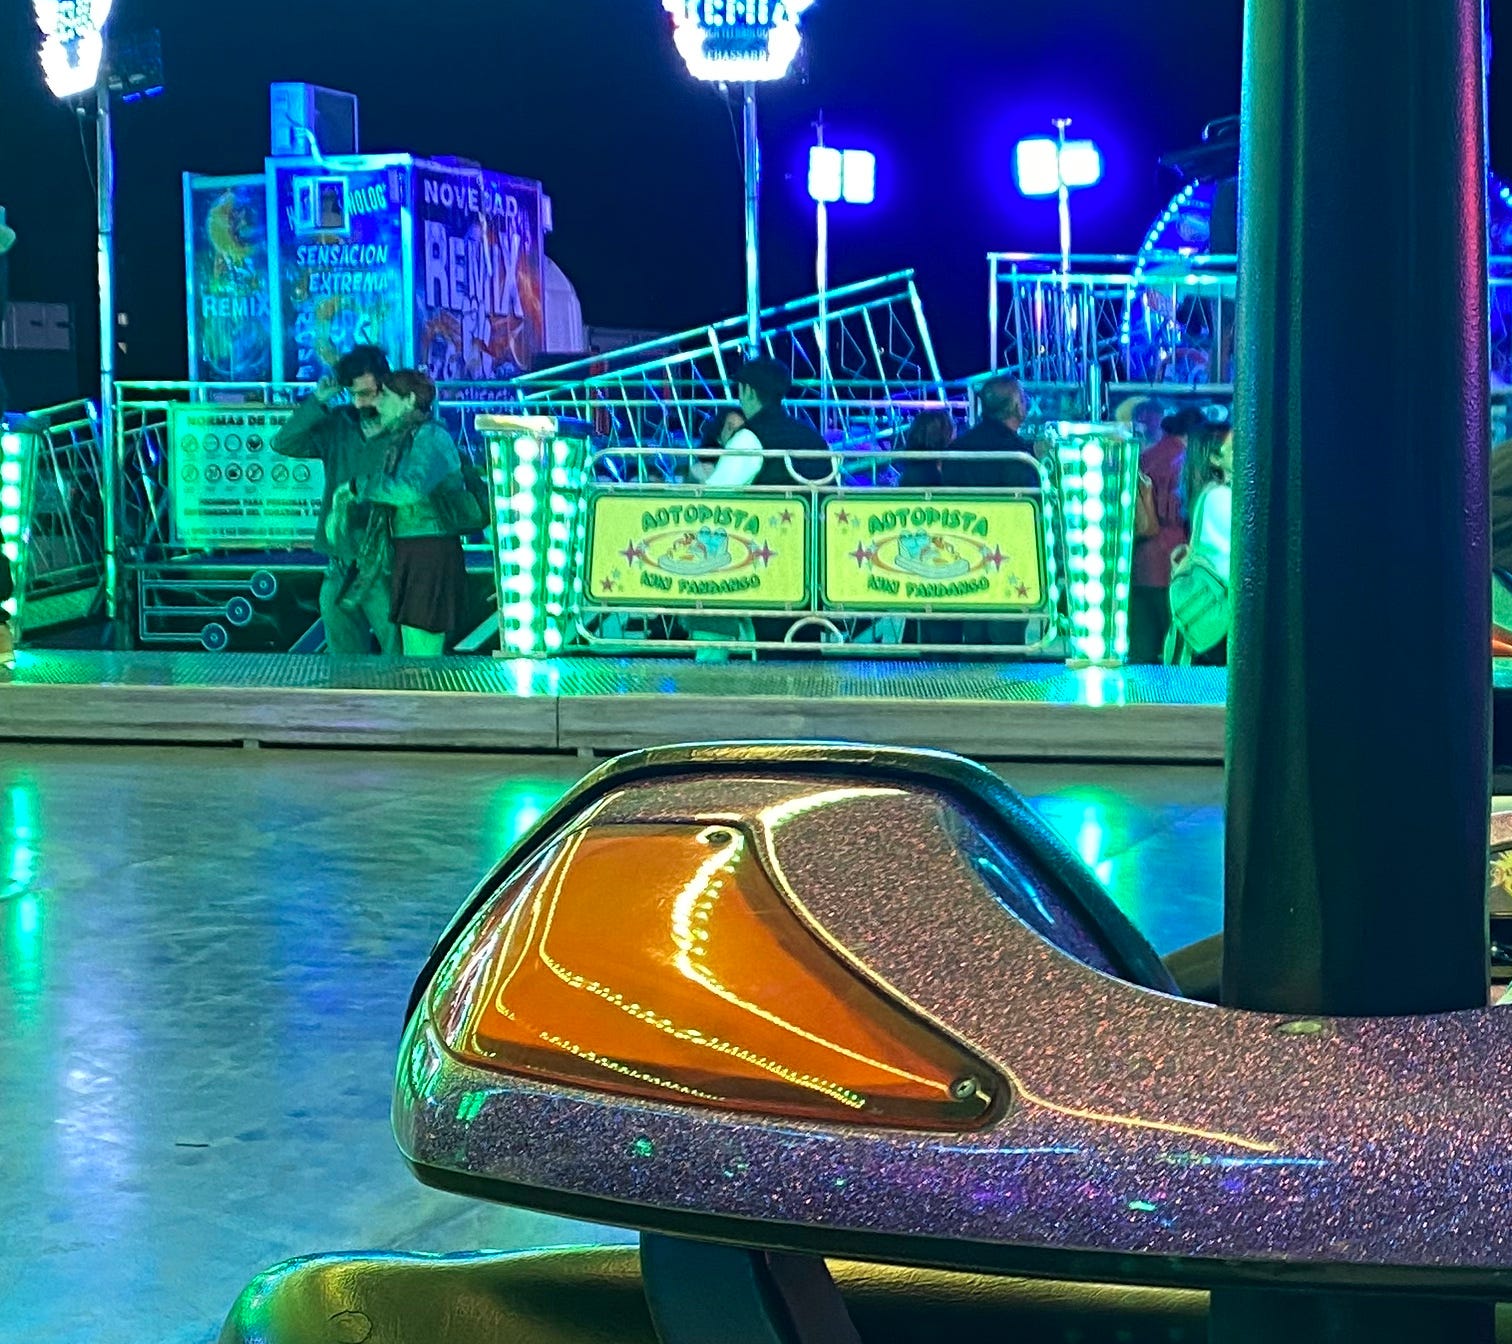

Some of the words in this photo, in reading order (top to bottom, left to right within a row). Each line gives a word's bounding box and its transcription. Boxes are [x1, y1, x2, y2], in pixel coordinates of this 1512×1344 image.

[424, 177, 518, 218] NOVEDAD
[297, 243, 389, 266] SENSACION
[424, 219, 524, 318] REMIX
[309, 271, 388, 296] EXTREMA
[201, 292, 271, 320] REMIX
[641, 504, 760, 535] AUTOPISTA
[867, 507, 989, 537] AUTOPISTA
